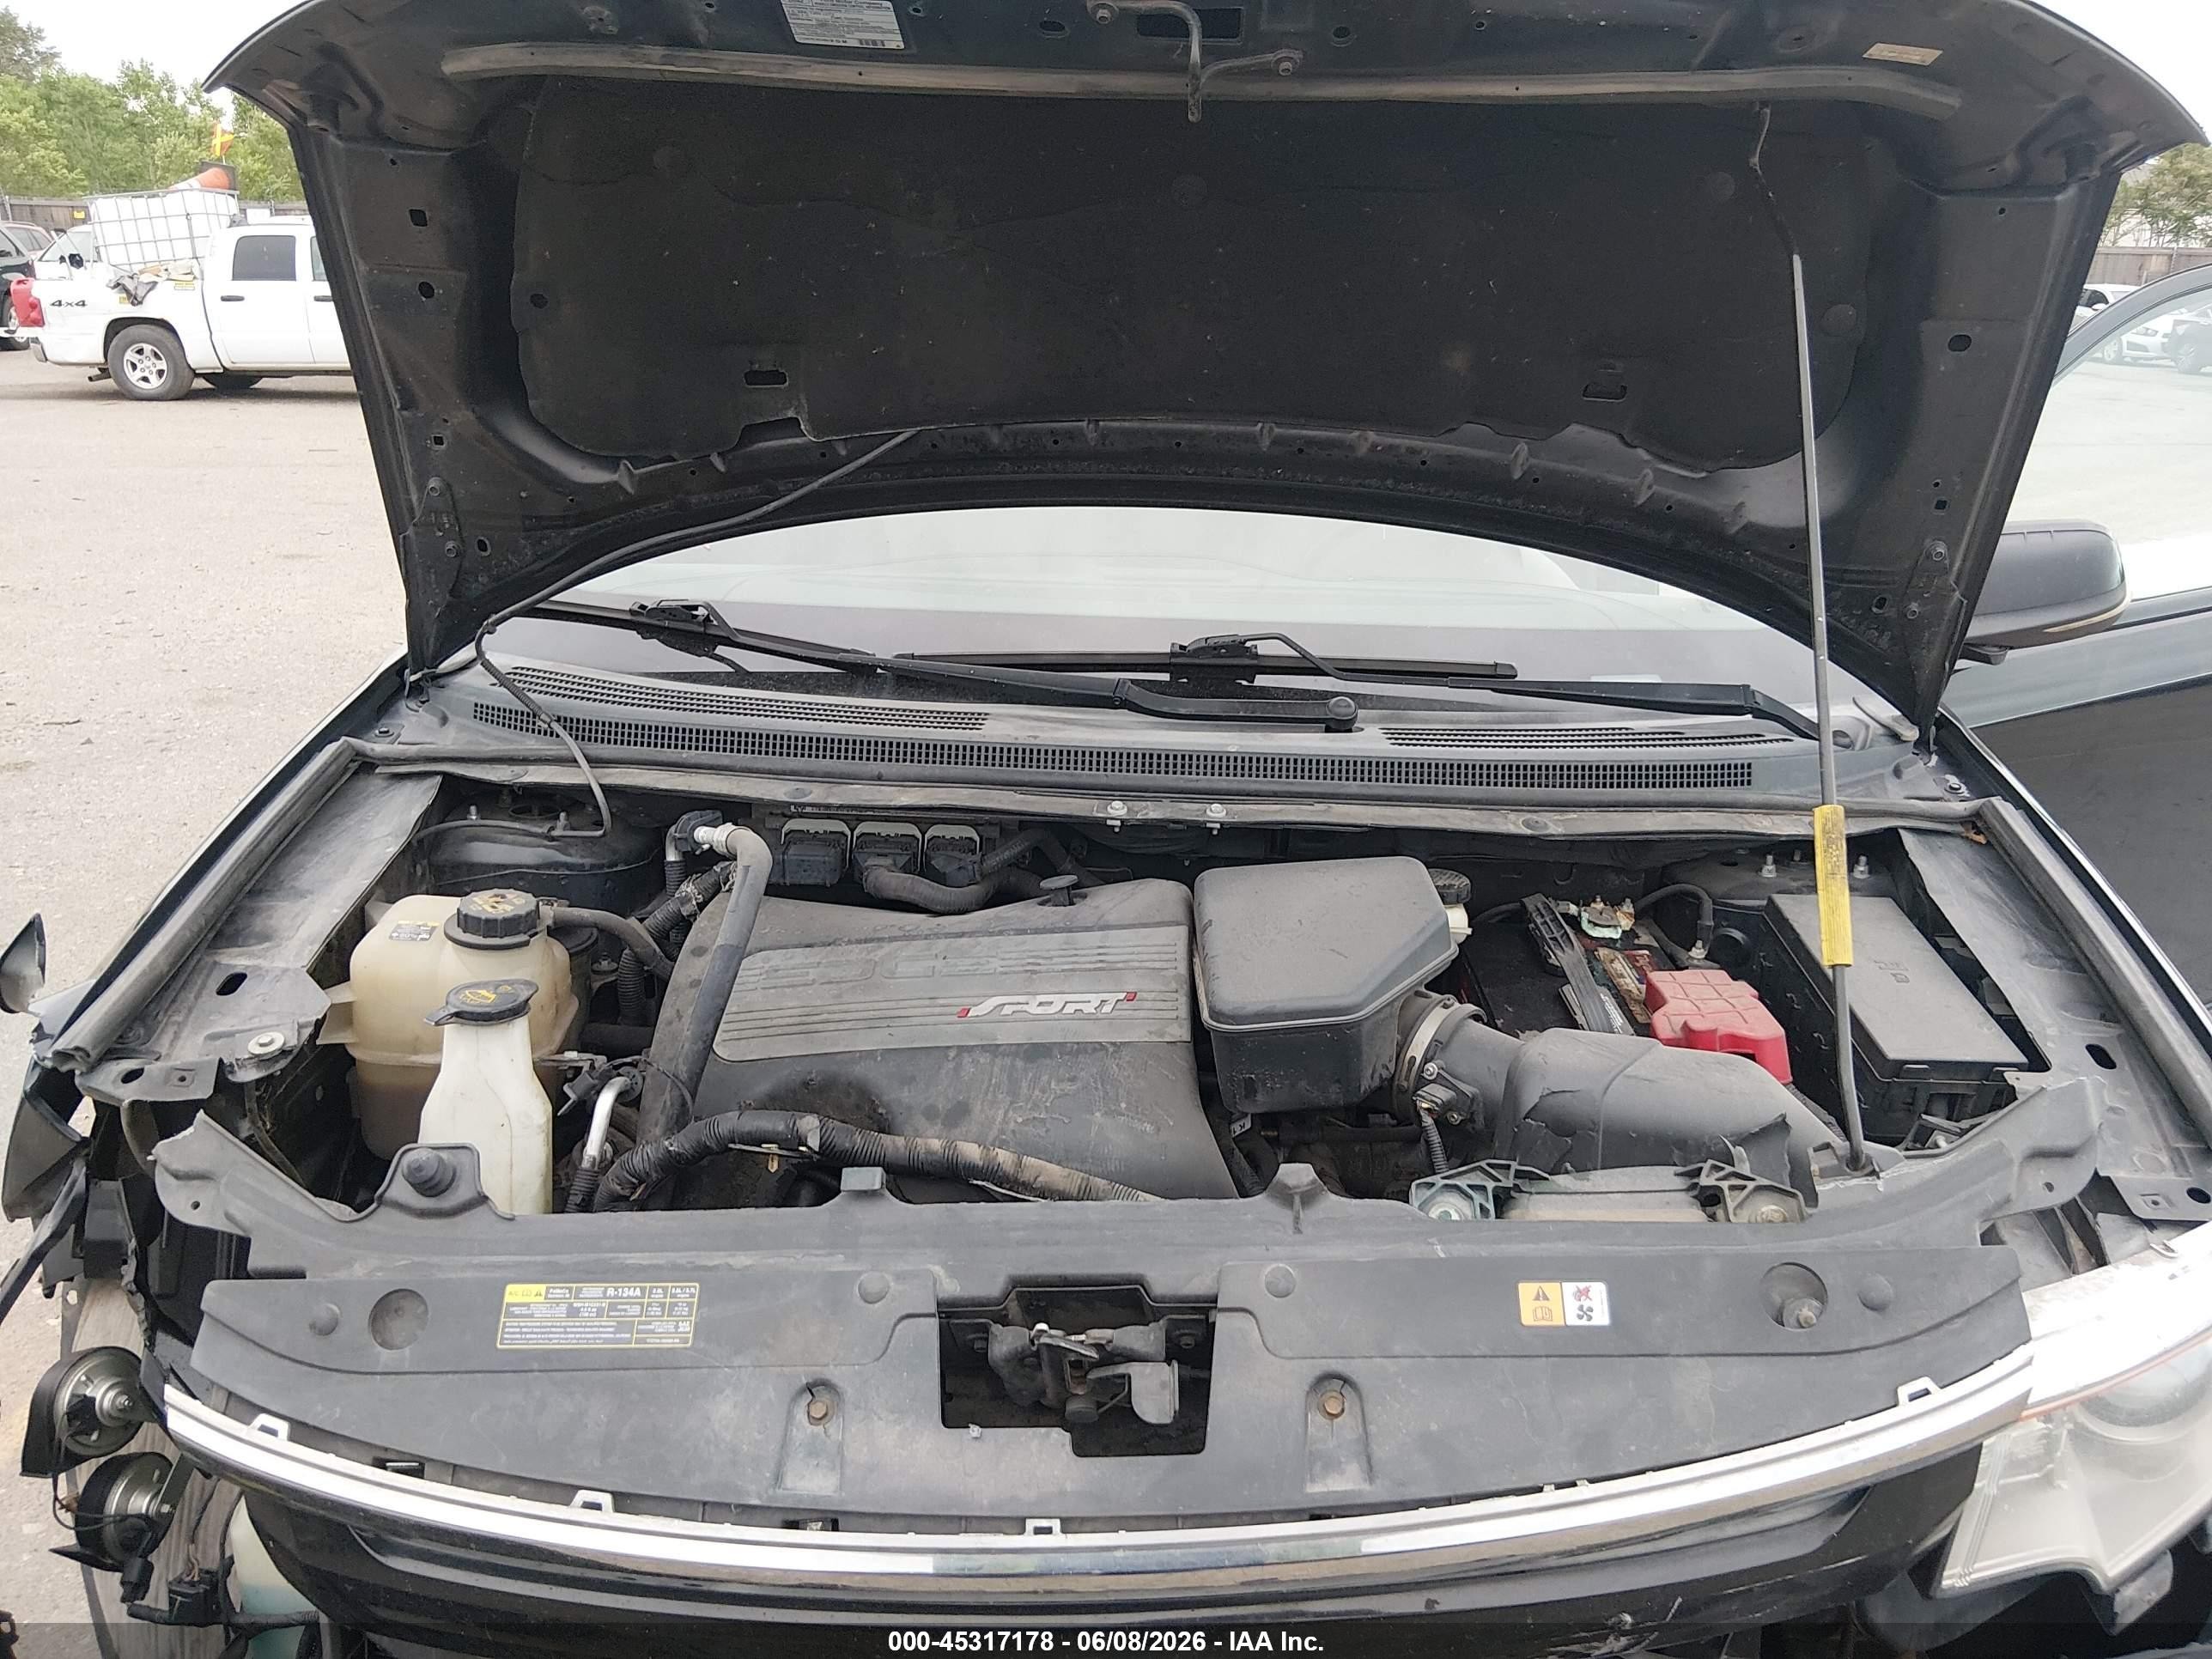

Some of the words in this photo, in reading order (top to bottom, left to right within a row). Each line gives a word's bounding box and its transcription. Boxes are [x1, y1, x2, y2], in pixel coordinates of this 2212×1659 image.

[49, 299, 88, 307] 4x4
[968, 993, 1127, 1018] SPORT
[606, 1287, 641, 1297] R-134A
